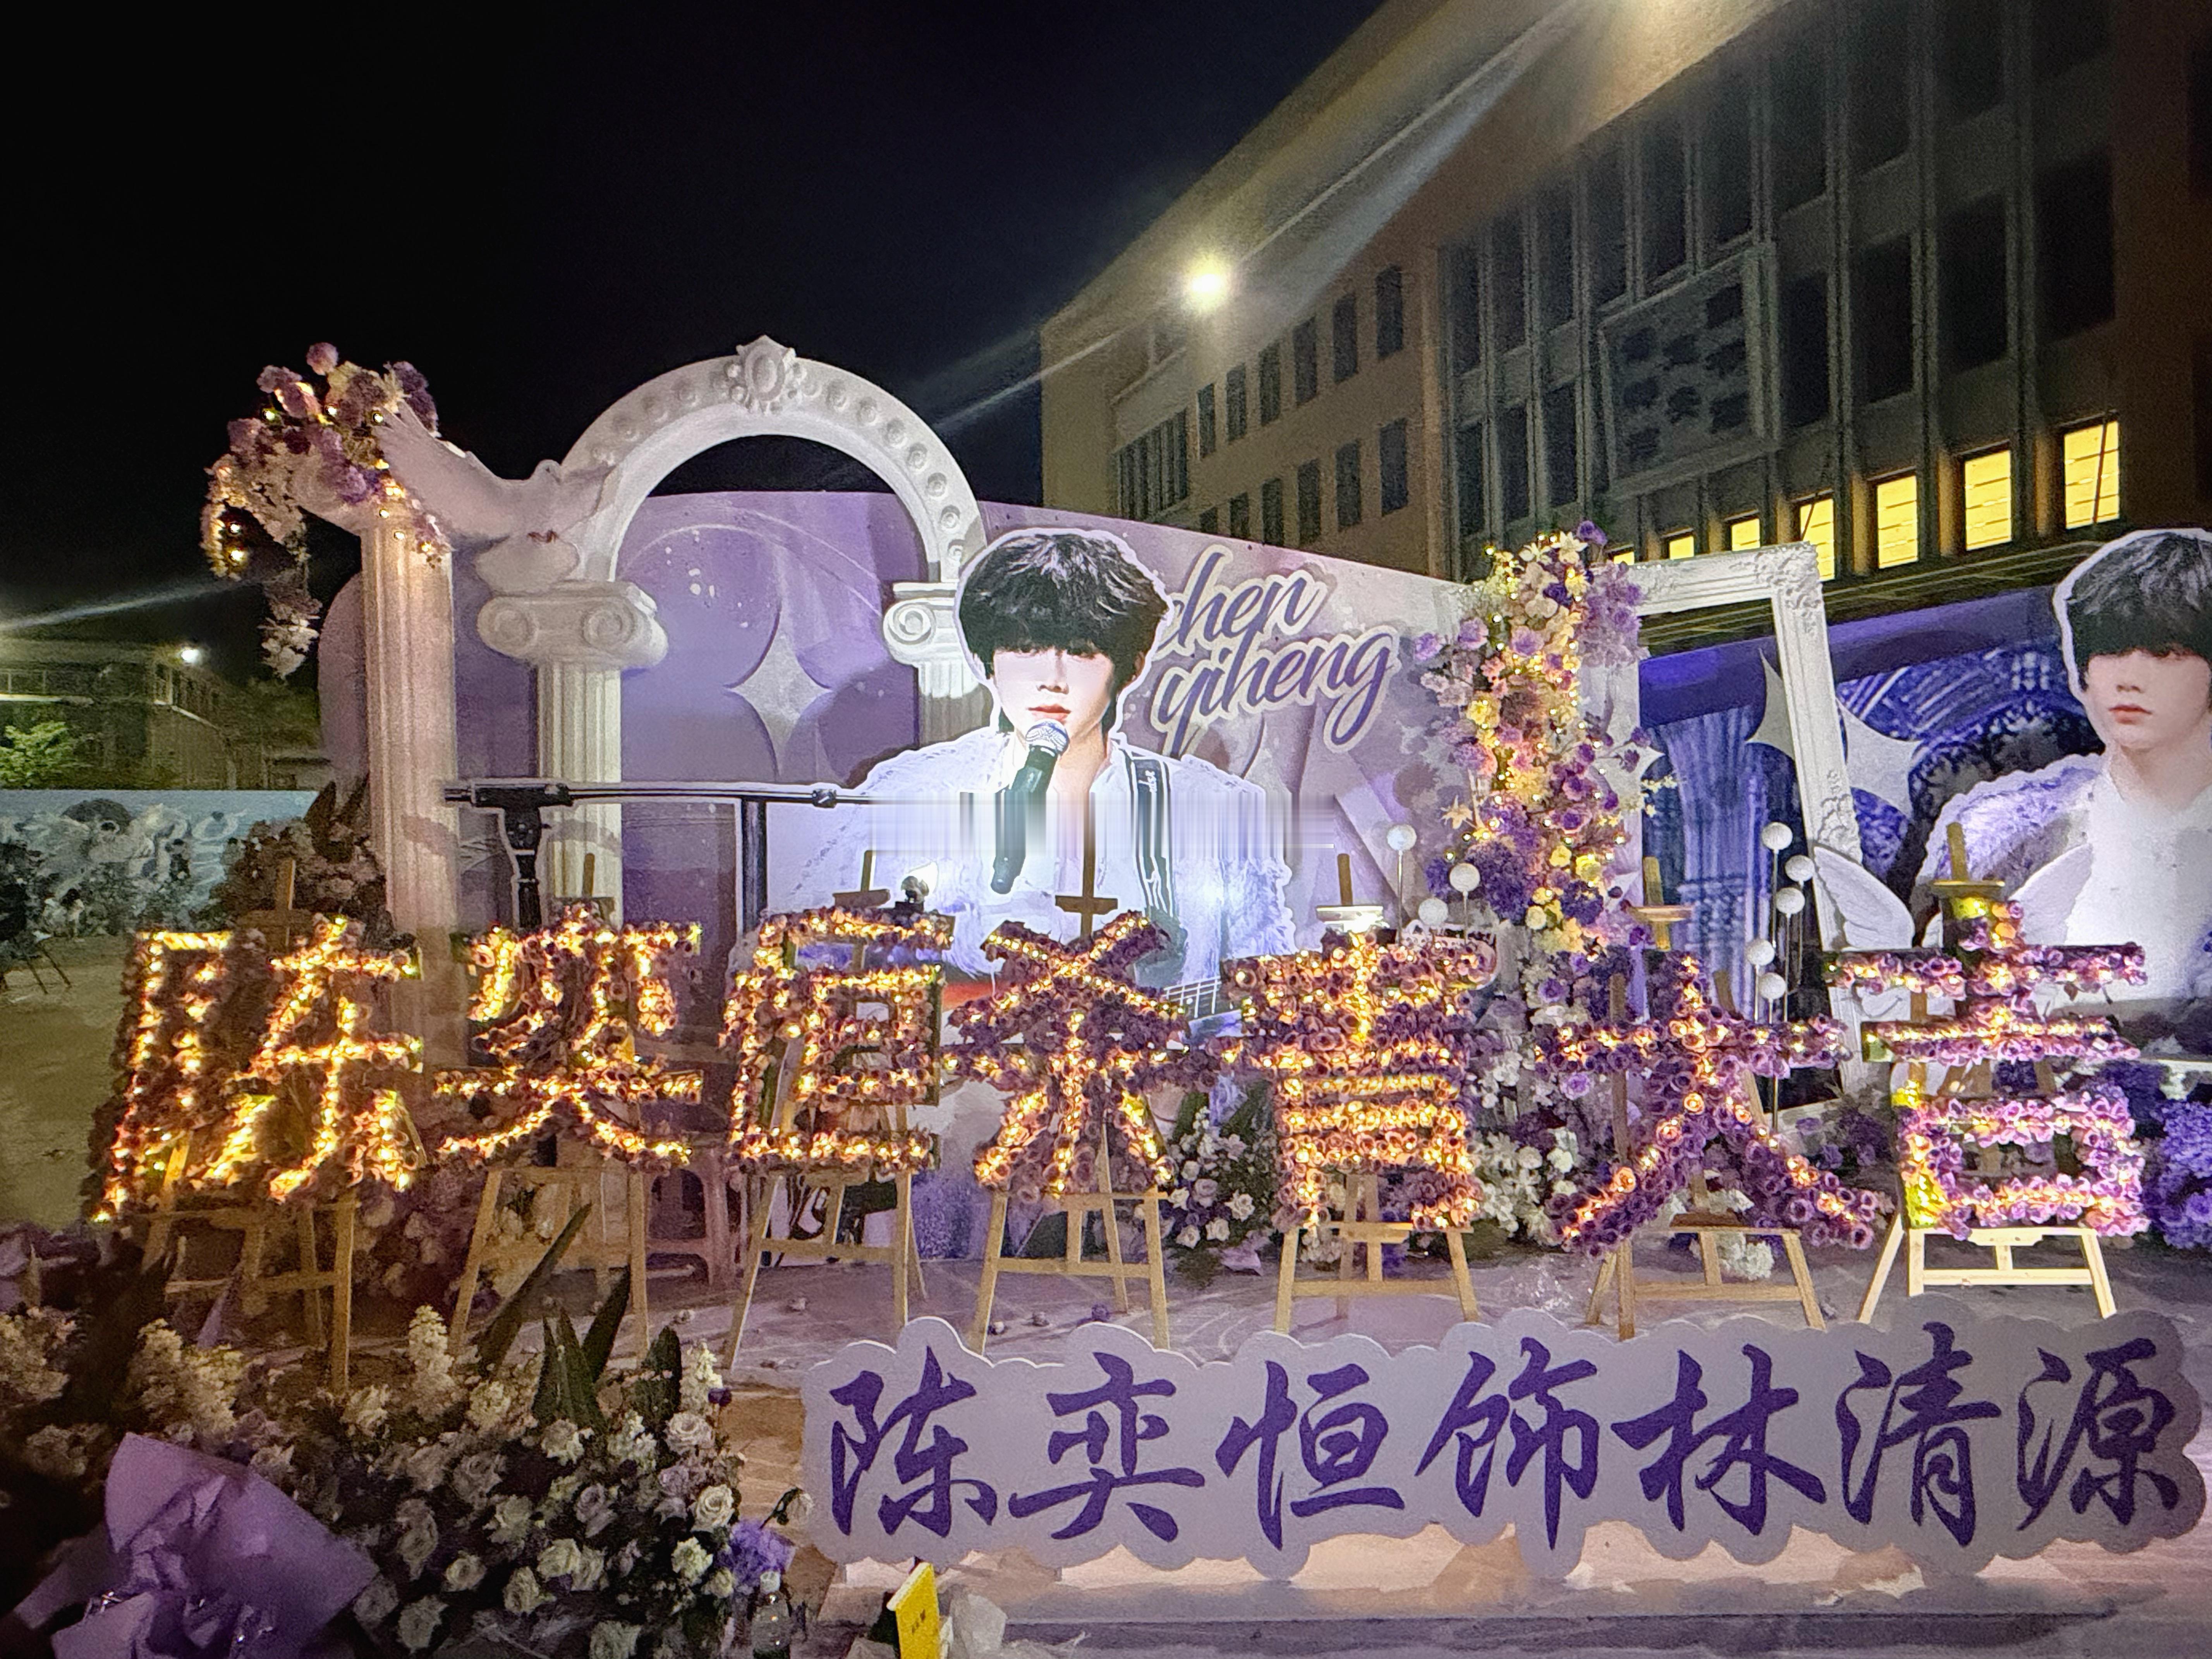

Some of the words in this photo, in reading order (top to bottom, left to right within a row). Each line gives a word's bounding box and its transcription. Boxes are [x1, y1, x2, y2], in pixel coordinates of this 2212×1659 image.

[93, 902, 2148, 1255] 陈奕恒杀青大吉
[829, 1321, 2179, 1550] 陈奕恒饰林清源
